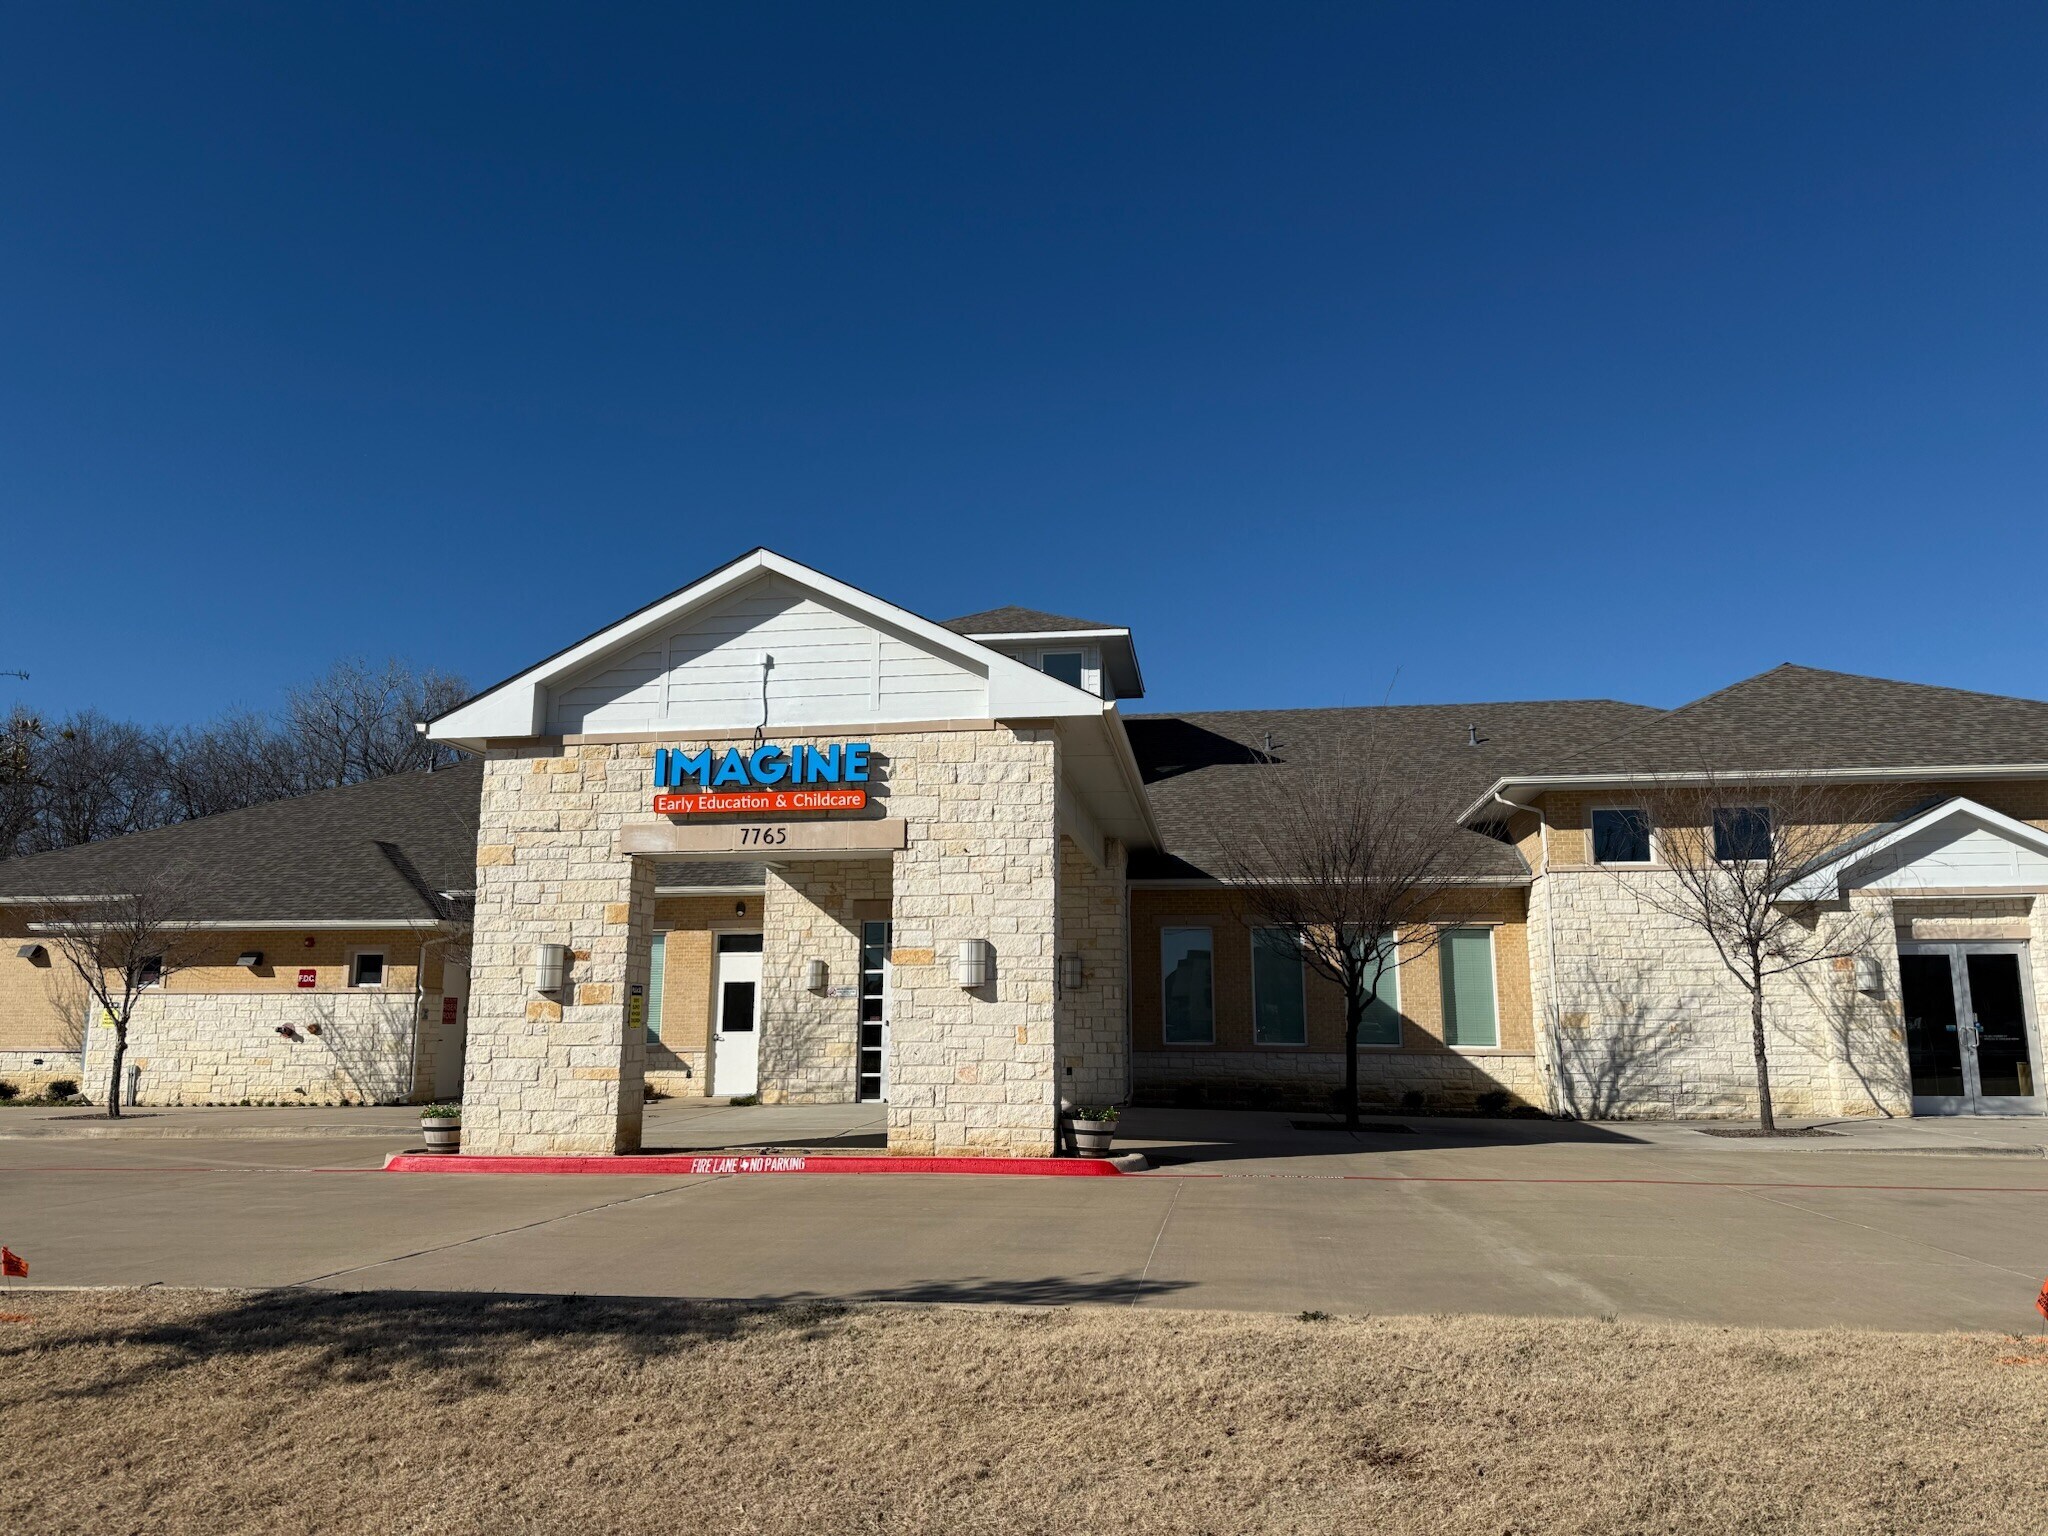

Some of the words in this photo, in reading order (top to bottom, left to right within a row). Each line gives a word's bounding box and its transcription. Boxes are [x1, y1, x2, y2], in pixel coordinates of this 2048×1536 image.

[654, 743, 871, 787] IMAGINE
[658, 797, 693, 812] Early
[699, 794, 769, 810] Education
[775, 794, 788, 808] &
[793, 793, 861, 807] Childcare
[740, 828, 786, 845] 7765
[691, 1158, 713, 1173] FIRE
[713, 1158, 739, 1173] LANE
[749, 1157, 763, 1172] NO
[764, 1157, 806, 1172] PARKING
